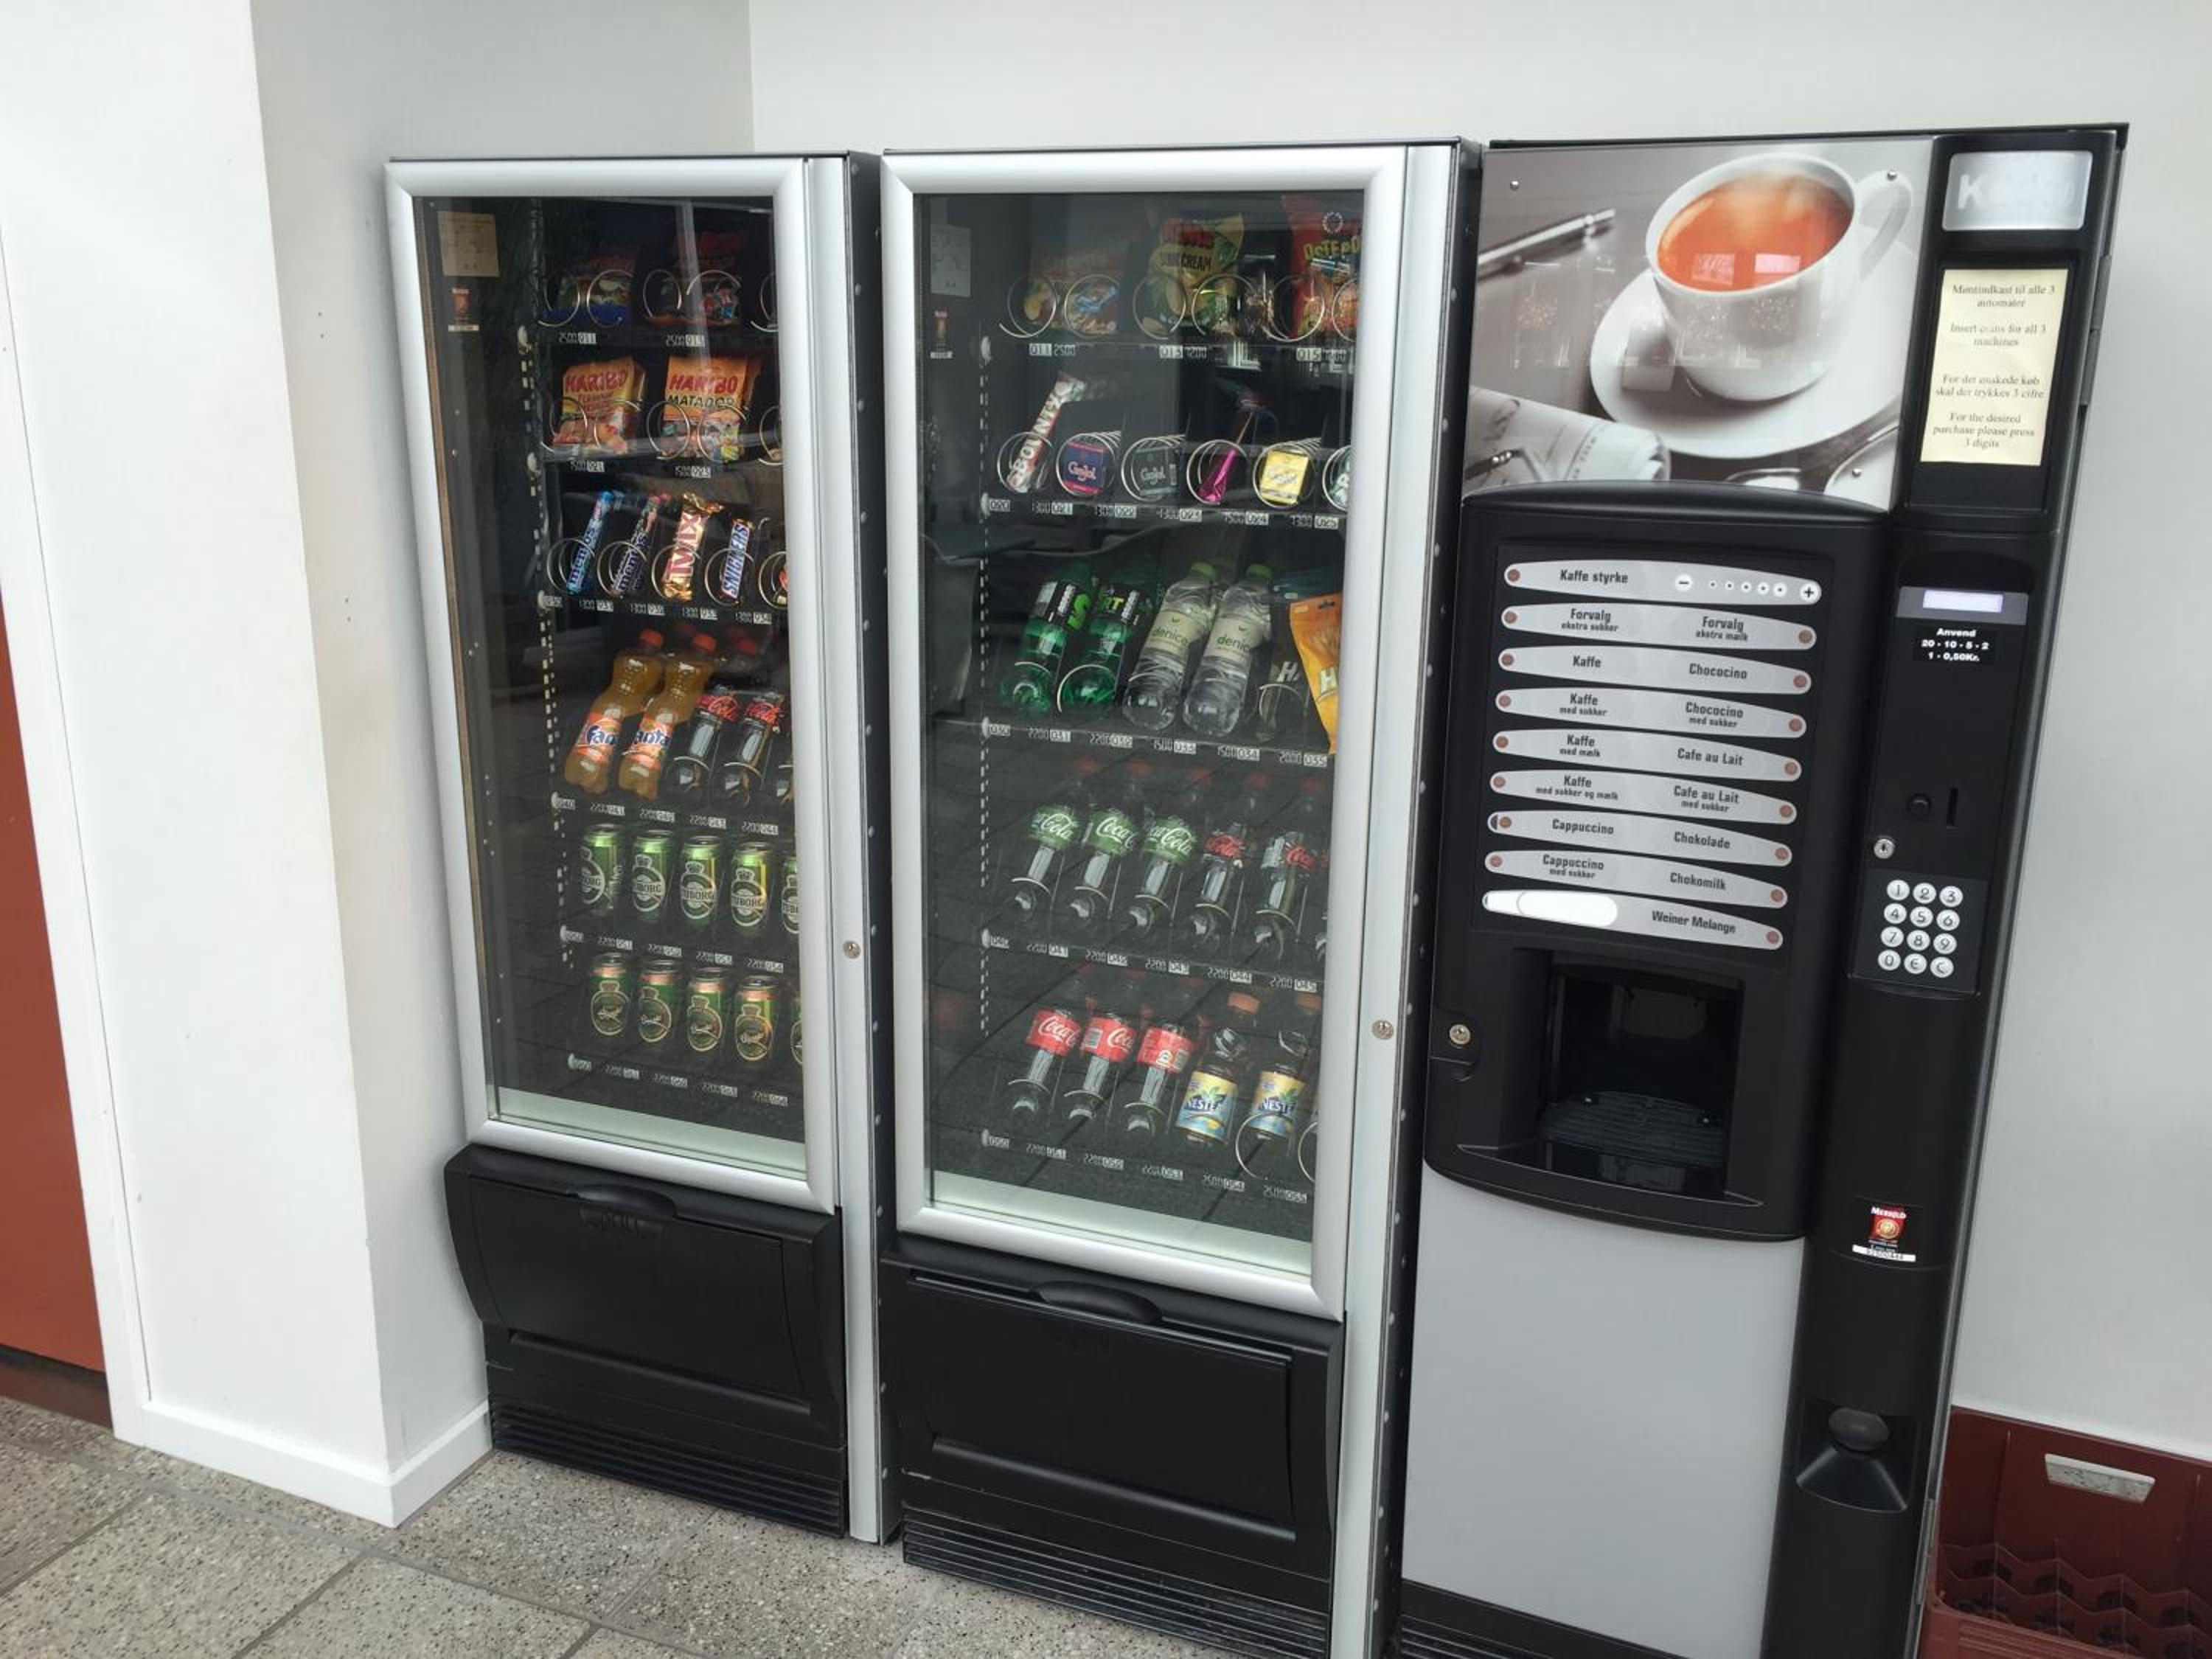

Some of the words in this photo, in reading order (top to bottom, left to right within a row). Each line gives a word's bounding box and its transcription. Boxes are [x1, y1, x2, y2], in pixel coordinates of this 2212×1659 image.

[2027, 285, 2046, 294] alle
[2049, 285, 2055, 294] 3
[1950, 323, 1977, 333] Insert
[2008, 324, 2021, 333] for
[2025, 324, 2037, 333] all
[2040, 324, 2046, 333] 3
[1973, 338, 2019, 346] machines
[566, 371, 627, 394] HARIBO
[1943, 375, 1959, 383] For
[1974, 389, 2010, 399] trykkes
[1950, 412, 1967, 421] For
[1969, 413, 1984, 422] the
[1986, 414, 2021, 423] desired
[1933, 425, 1975, 435] purchase
[1977, 426, 2008, 437] please
[2009, 428, 2035, 437] press
[1972, 438, 2000, 449] digits
[723, 523, 749, 596] SNICKERS
[1559, 570, 1590, 582] Kaffe
[1593, 571, 1629, 585] styrke
[1571, 608, 1611, 623] Forvalg
[1562, 623, 1587, 631] ekstra
[1590, 622, 1618, 633] sukker
[1703, 616, 1744, 632] Forvalg
[1696, 630, 1723, 640] ekstra
[1936, 628, 1977, 637] Anvend
[1921, 639, 1935, 648] 20
[1944, 641, 1958, 649] 10
[1981, 642, 1989, 650] 2
[1573, 655, 1601, 668] Kaffe
[1688, 664, 1747, 680] Chococino
[1570, 694, 1599, 706] Kaffe
[1559, 707, 1576, 715] med
[1579, 707, 1607, 717] sukker
[1686, 702, 1744, 719] Chococino
[1689, 717, 1708, 726] med
[1710, 718, 1738, 728] sukker
[1567, 734, 1595, 747] Kaffe
[1559, 748, 1576, 756] med
[1579, 748, 1601, 758] mælk
[1677, 748, 1703, 761] Cafe
[1705, 754, 1719, 763] au
[1722, 752, 1744, 766] Lait
[1564, 775, 1592, 787] Kaffe
[1536, 787, 1552, 795] med
[1554, 787, 1582, 797] sukker
[1585, 790, 1595, 799] og
[1596, 790, 1618, 801] mælk
[1674, 785, 1699, 799] Cafe
[1701, 791, 1716, 801] au
[1718, 790, 1739, 804] Lait
[1681, 799, 1700, 810] med
[1702, 801, 1730, 813] sukker
[1552, 818, 1614, 835] Cappuccino
[1674, 831, 1731, 849] Chokolade
[1543, 854, 1604, 871] Cappuccino
[1549, 868, 1567, 876] med
[1670, 872, 1726, 891] Chokomilk
[1920, 888, 1930, 900] 2
[1946, 891, 1955, 903] 3
[1652, 911, 1689, 927] Weiner
[1691, 916, 1736, 933] Melange
[1891, 908, 1899, 920] 4
[1917, 911, 1926, 922] 5
[1943, 916, 1952, 926] 6
[1890, 931, 1897, 943] 7
[1914, 935, 1923, 947] 8
[1941, 938, 1950, 950] 9
[1885, 955, 1893, 967] 0
[1910, 958, 1919, 970] E
[1937, 962, 1946, 974] C
